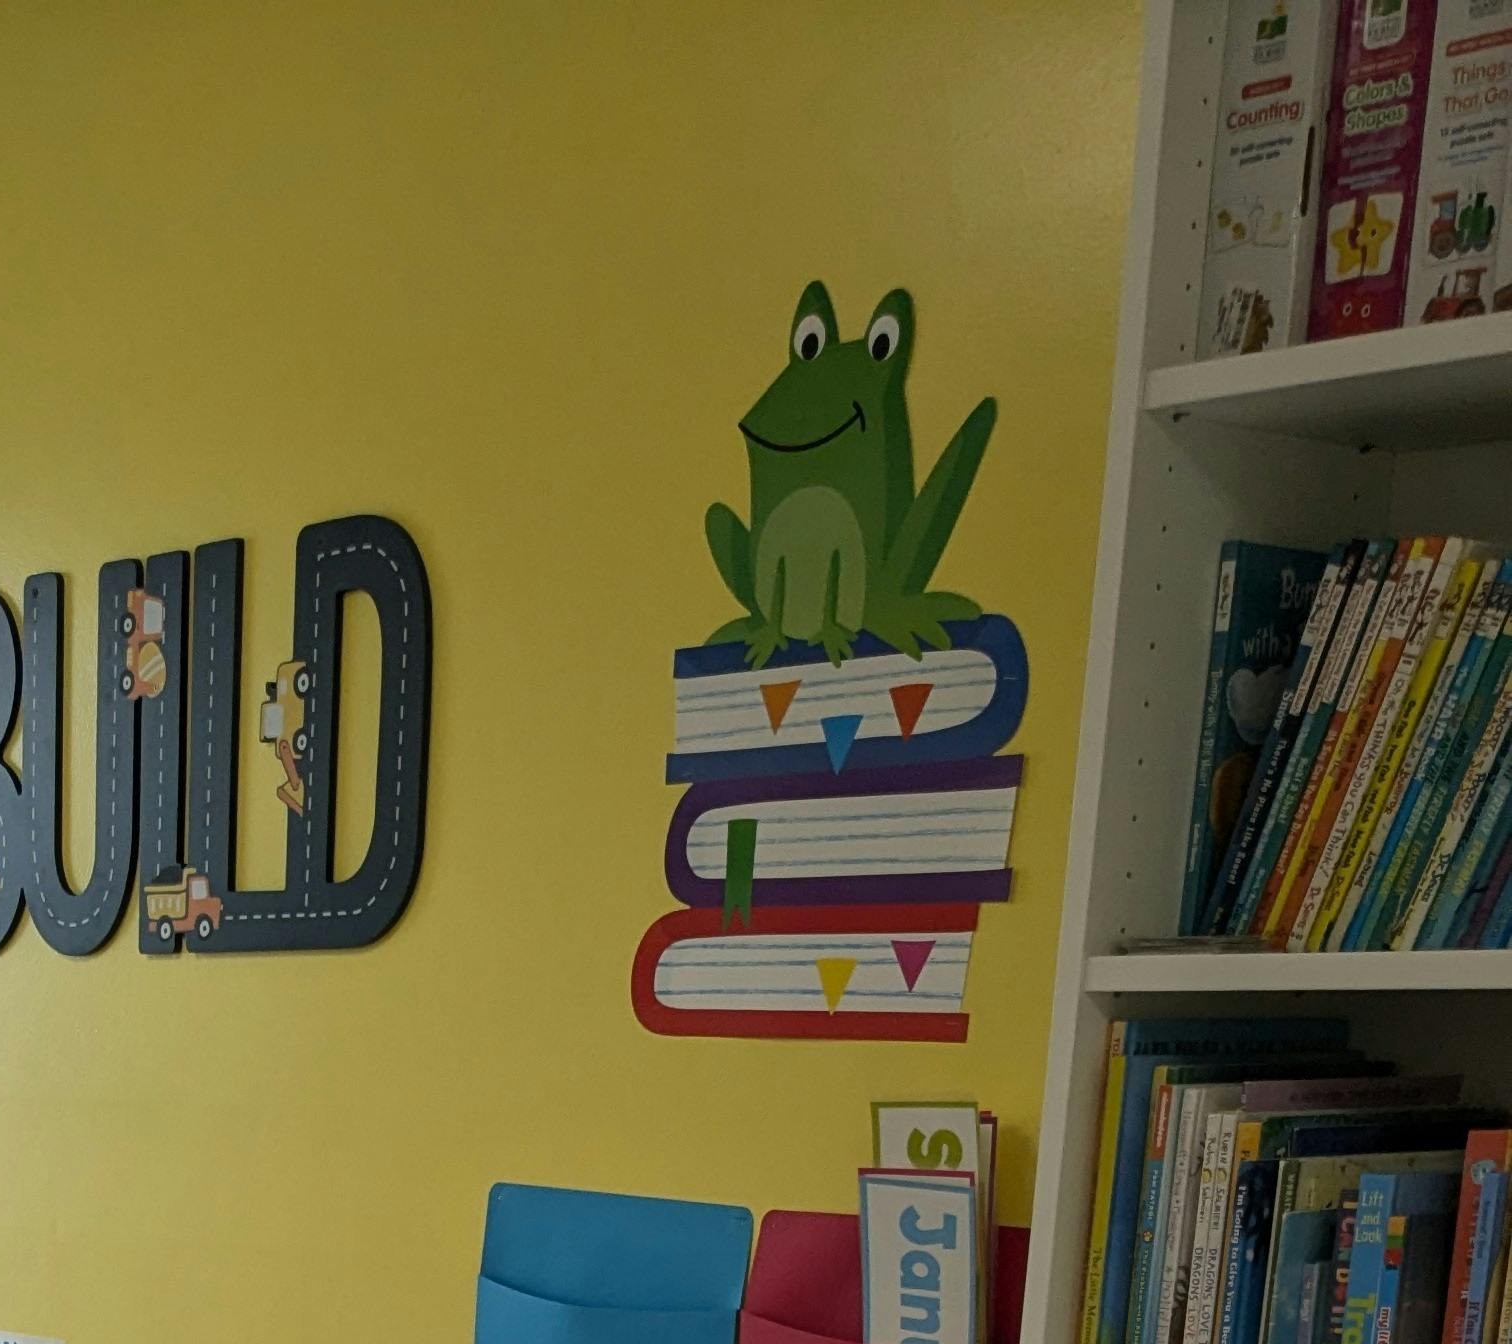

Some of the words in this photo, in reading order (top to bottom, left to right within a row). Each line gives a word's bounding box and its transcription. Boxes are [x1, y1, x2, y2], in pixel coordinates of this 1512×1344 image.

[1226, 100, 1301, 130] Counting
[1354, 1226, 1383, 1243] Look
[1202, 1248, 1219, 1301] DRAGONS
[1198, 1303, 1213, 1337] LOVE
